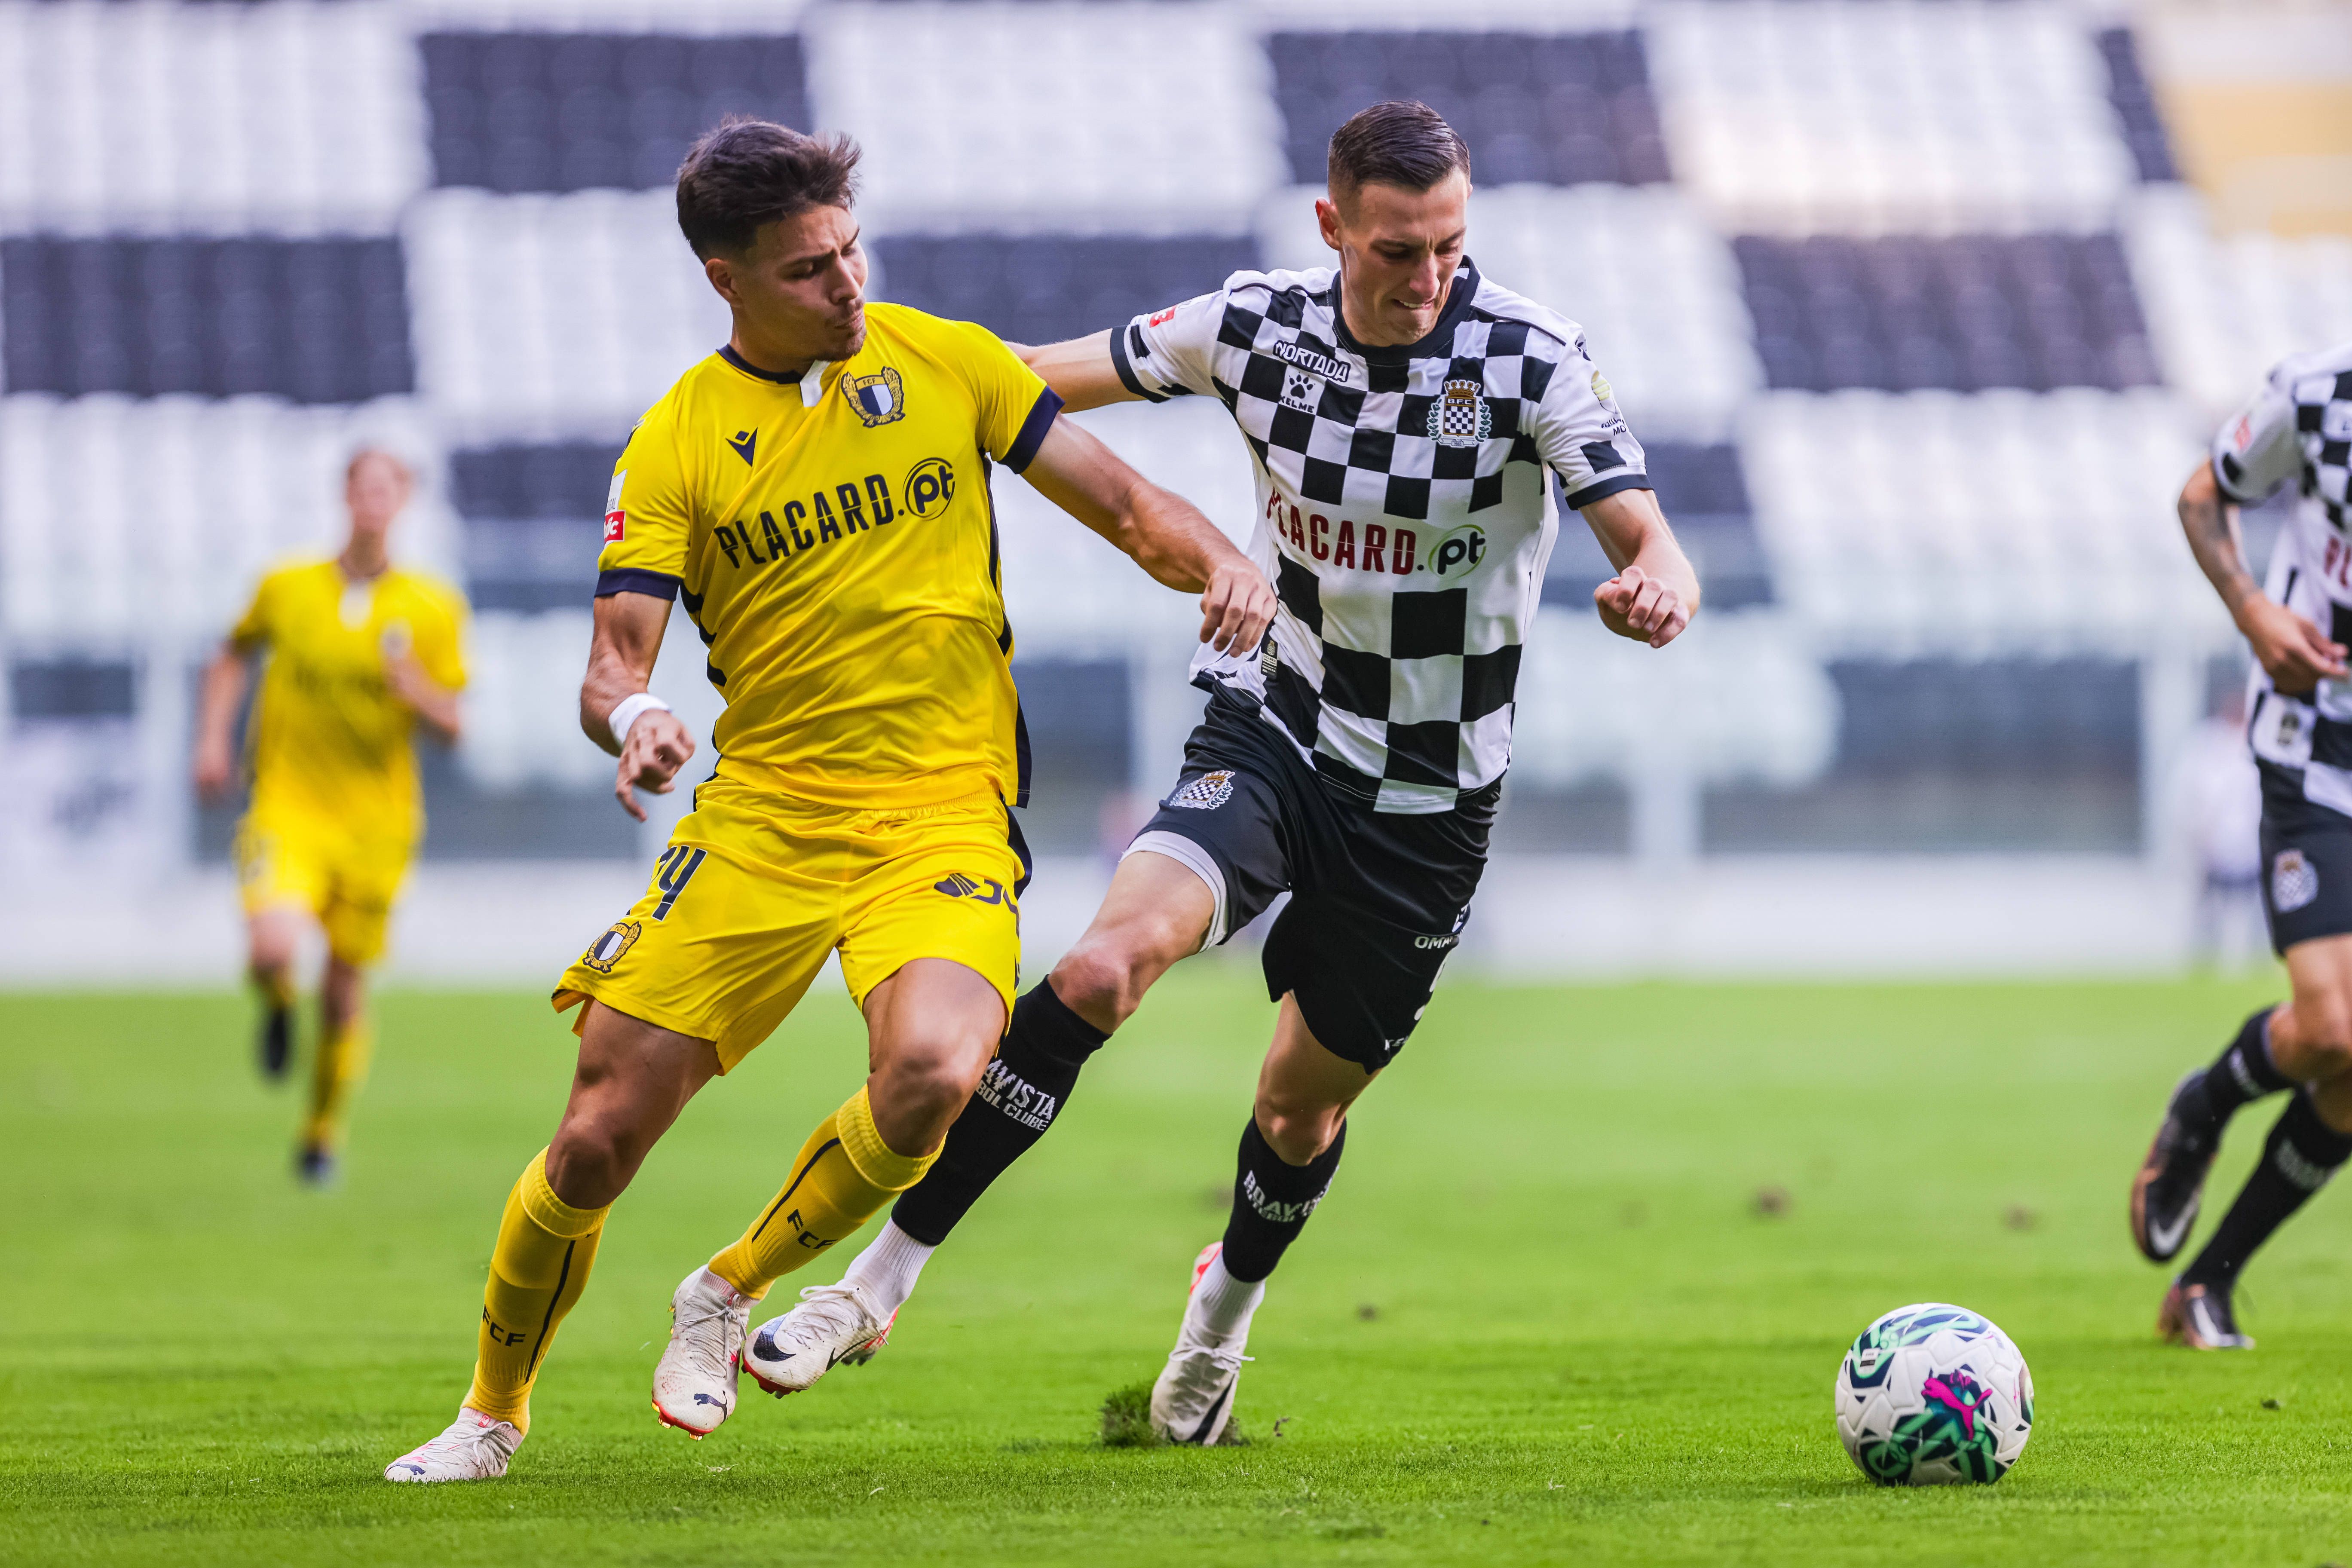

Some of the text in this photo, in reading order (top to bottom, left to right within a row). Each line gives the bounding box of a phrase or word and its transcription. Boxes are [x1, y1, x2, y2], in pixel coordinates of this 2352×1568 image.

[863, 377, 876, 386] FCF
[1275, 342, 1348, 381] NORTADA
[1279, 395, 1314, 413] KELME
[976, 1080, 1049, 1131] BOL CLUBE
[984, 1059, 1055, 1121] AVISTA
[787, 1208, 838, 1249] FCF
[482, 1303, 526, 1347] FCF
